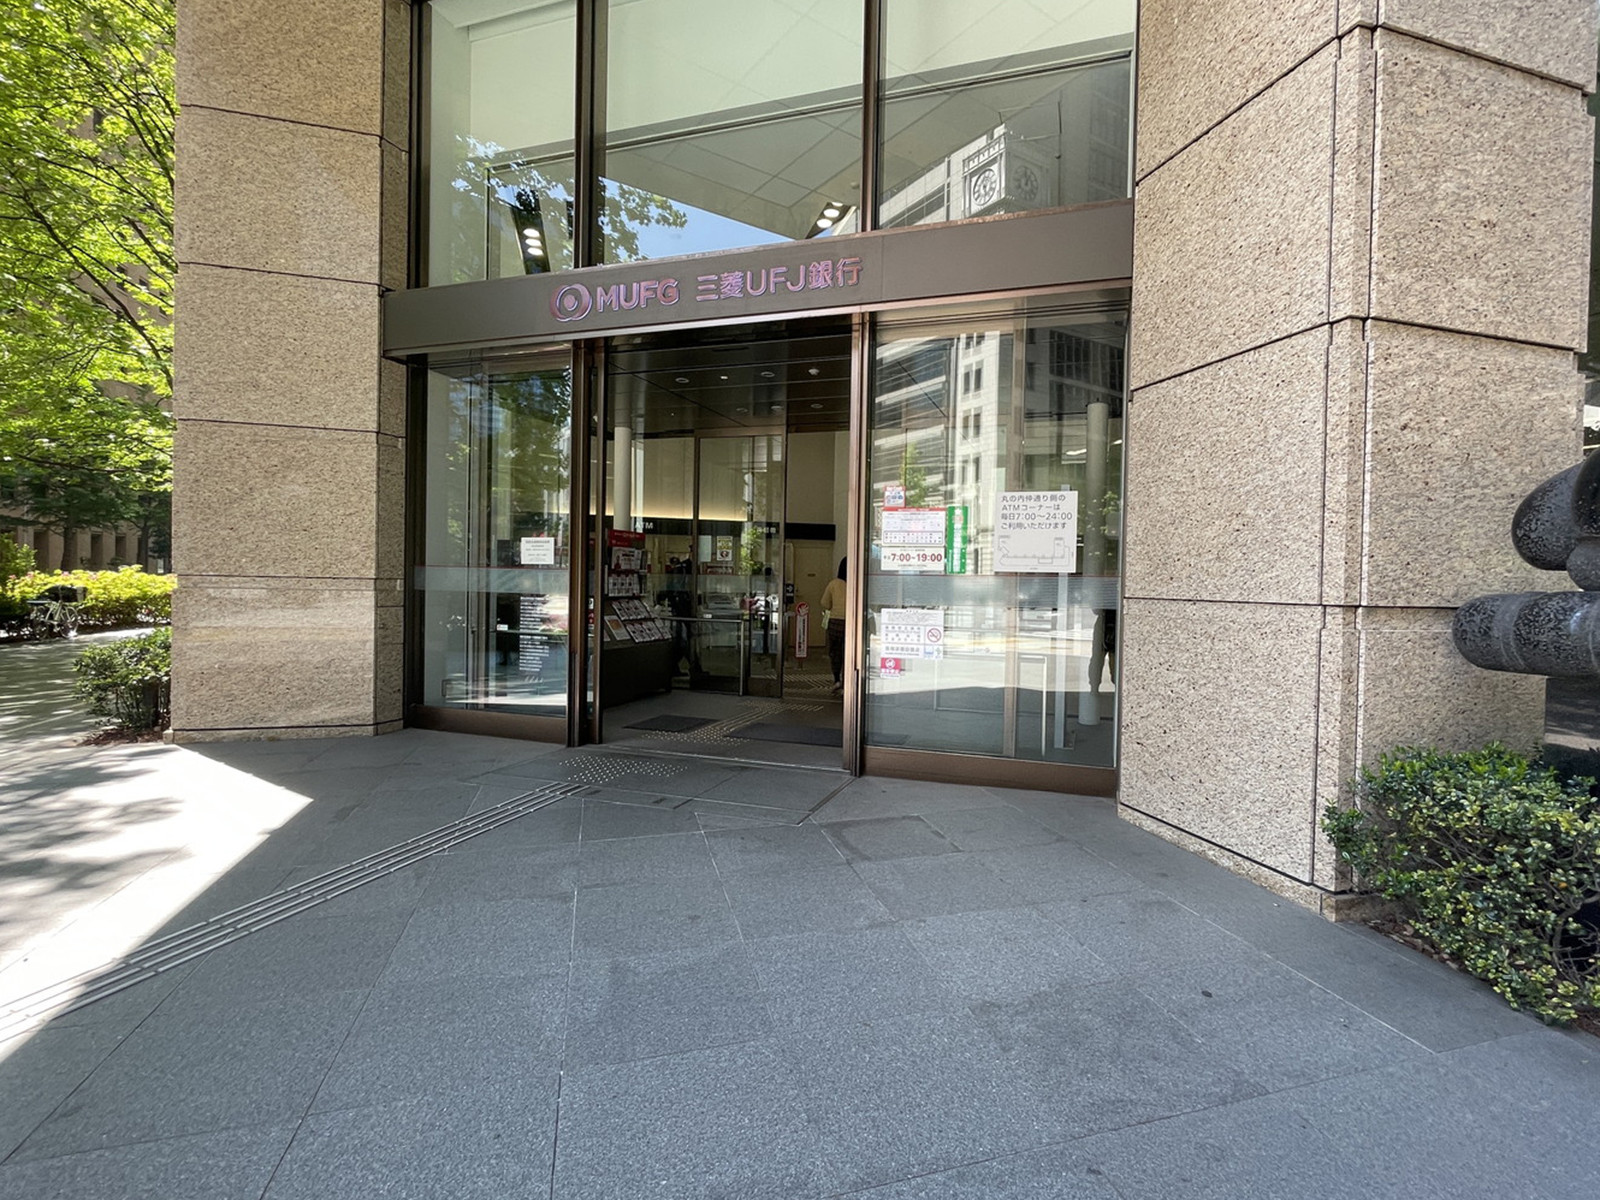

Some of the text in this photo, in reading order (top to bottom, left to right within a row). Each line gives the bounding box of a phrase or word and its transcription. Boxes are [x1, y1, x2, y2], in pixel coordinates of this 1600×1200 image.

[596, 278, 680, 313] MUFG
[695, 256, 863, 302] 三菱UFJ銀行
[1000, 522, 1067, 530] ご利用いただけます
